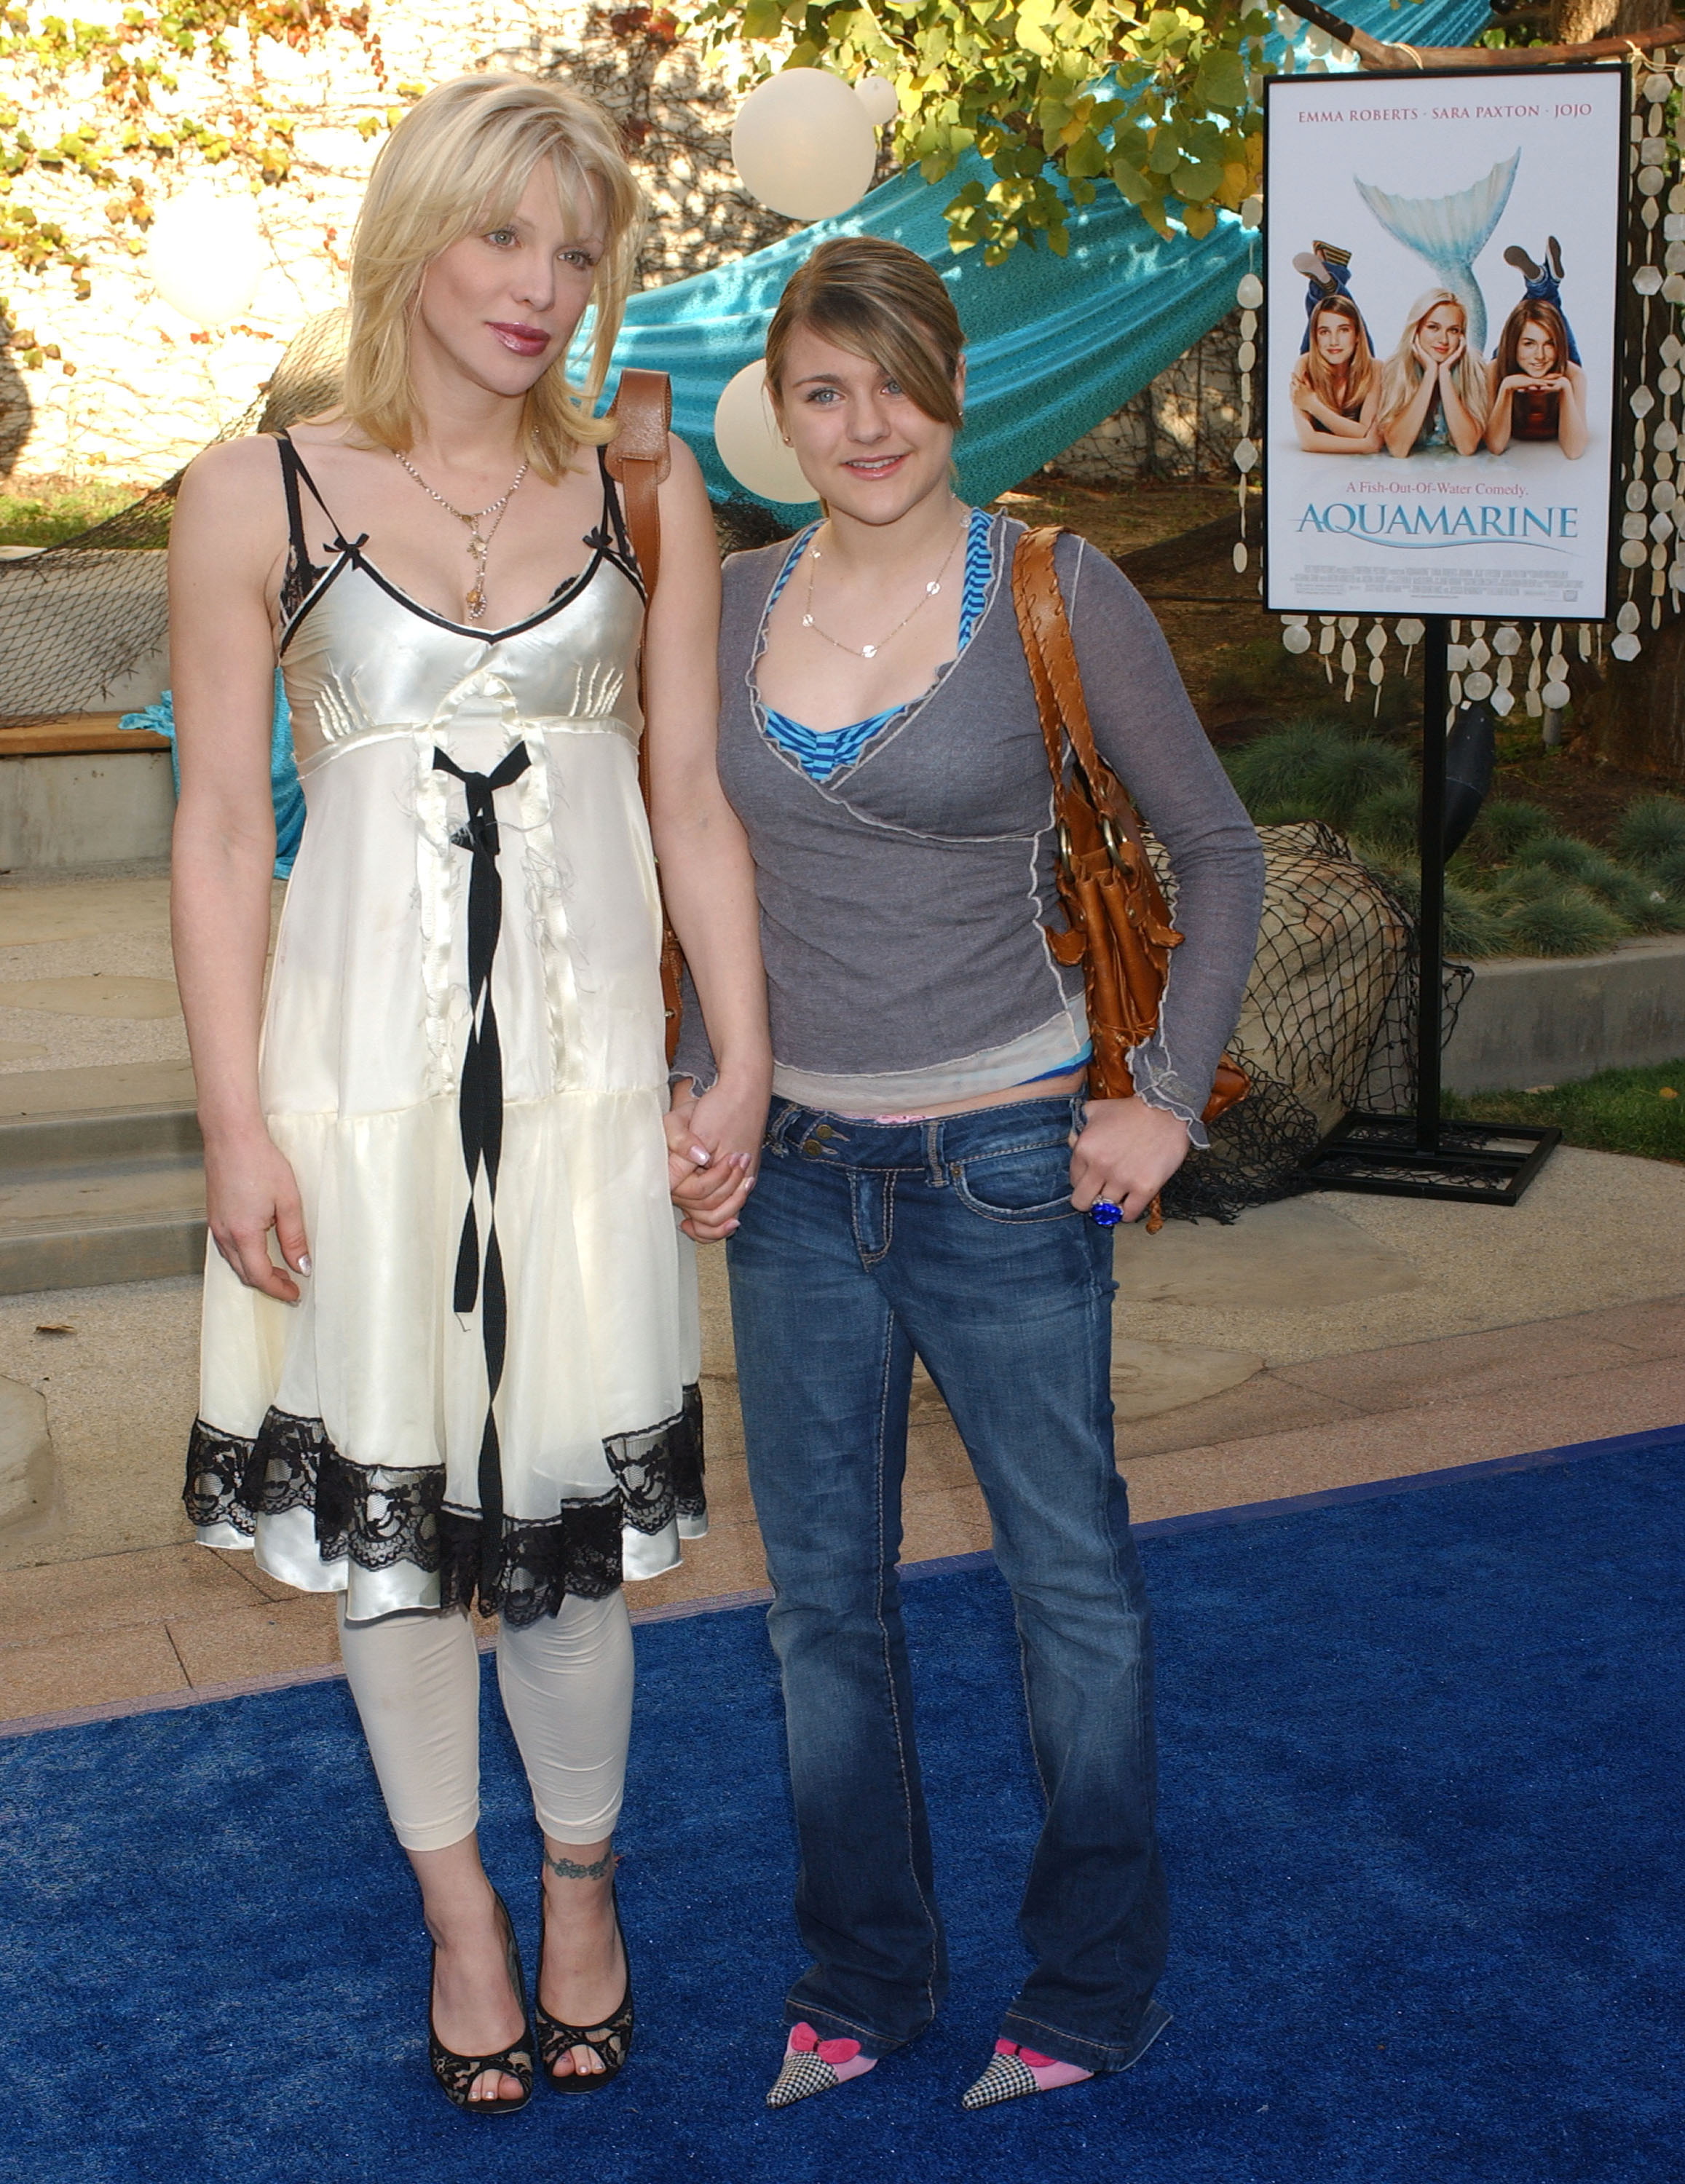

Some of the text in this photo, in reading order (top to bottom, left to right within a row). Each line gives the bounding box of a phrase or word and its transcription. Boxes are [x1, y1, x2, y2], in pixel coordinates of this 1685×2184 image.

[1298, 103, 1593, 123] EMMA ROBERTS SARA PAXTON JOJO
[1346, 481, 1529, 499] A Fish-Out-Of-Water Comedy.
[1293, 502, 1579, 541] AQUAMARINE
